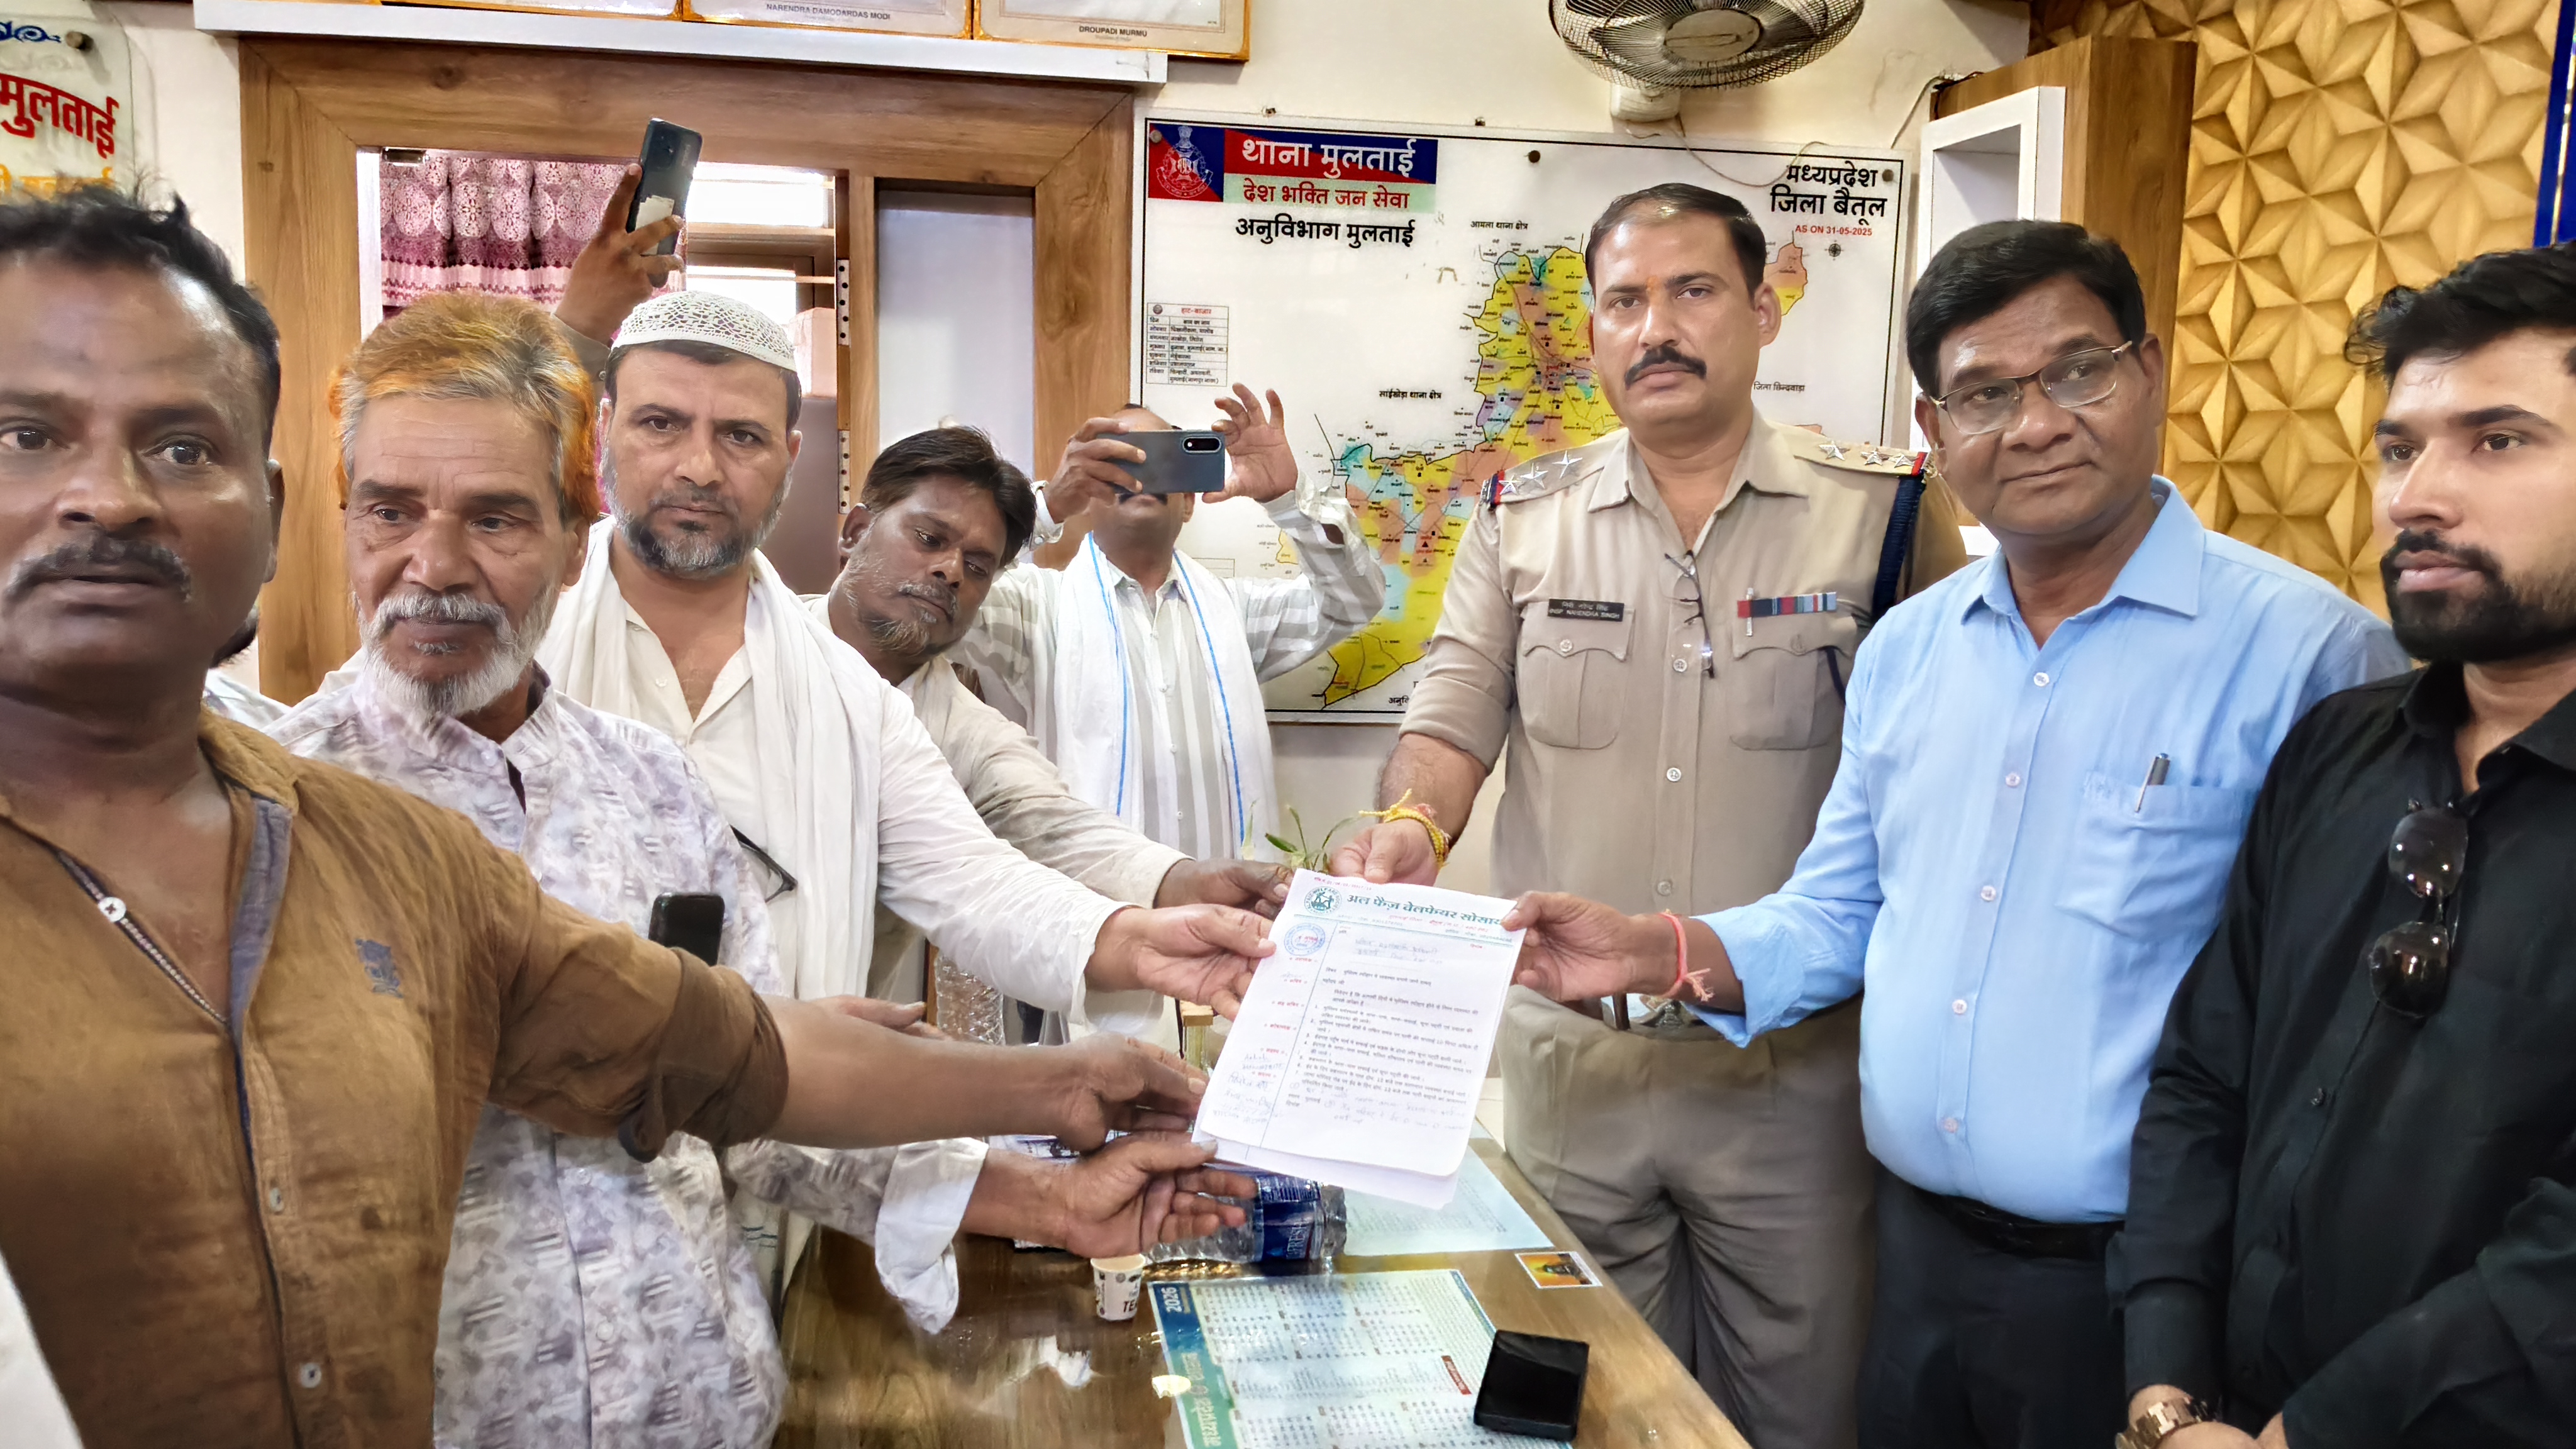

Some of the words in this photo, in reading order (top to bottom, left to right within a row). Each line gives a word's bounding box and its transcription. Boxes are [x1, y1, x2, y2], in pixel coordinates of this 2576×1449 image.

[767, 3, 811, 14] NARENDRA
[812, 7, 869, 19] DAMODARDAS
[870, 11, 891, 20] MODI
[1079, 26, 1118, 35] DROUPADI
[1119, 28, 1148, 37] MURMU
[1242, 138, 1313, 167] थाना
[1320, 138, 1417, 179] मुलताई
[1786, 160, 1879, 187] मध्यप्रदेश
[1243, 177, 1276, 203] देश
[1282, 180, 1330, 205] भक्ति
[1335, 189, 1367, 206] जन
[1372, 184, 1410, 209] सेवा
[1770, 184, 1827, 214] जिला
[1833, 187, 1888, 226] बैतूल
[1235, 213, 1341, 245] अनुविभाग
[1346, 219, 1416, 249] मुलताई
[1470, 220, 1494, 229] आमला
[1496, 221, 1513, 230] थाना
[1515, 219, 1528, 230] क्षेत्र
[1795, 225, 1807, 233] AS
[1810, 225, 1824, 234] ON
[1826, 226, 1873, 236] 31-05-2025
[1379, 388, 1408, 400] साईखेड़ा
[1409, 391, 1428, 399] थाना
[1428, 389, 1442, 400] क्षेत्र
[1753, 380, 1772, 391] जिला
[1773, 381, 1806, 394] छिन्दवाड़ा
[1346, 894, 1370, 905] अल
[1402, 900, 1458, 919] वेलफेयर
[1460, 911, 1503, 926] सोसाय
[1123, 1299, 1137, 1313] TE
[1161, 1286, 1183, 1313] 2026
